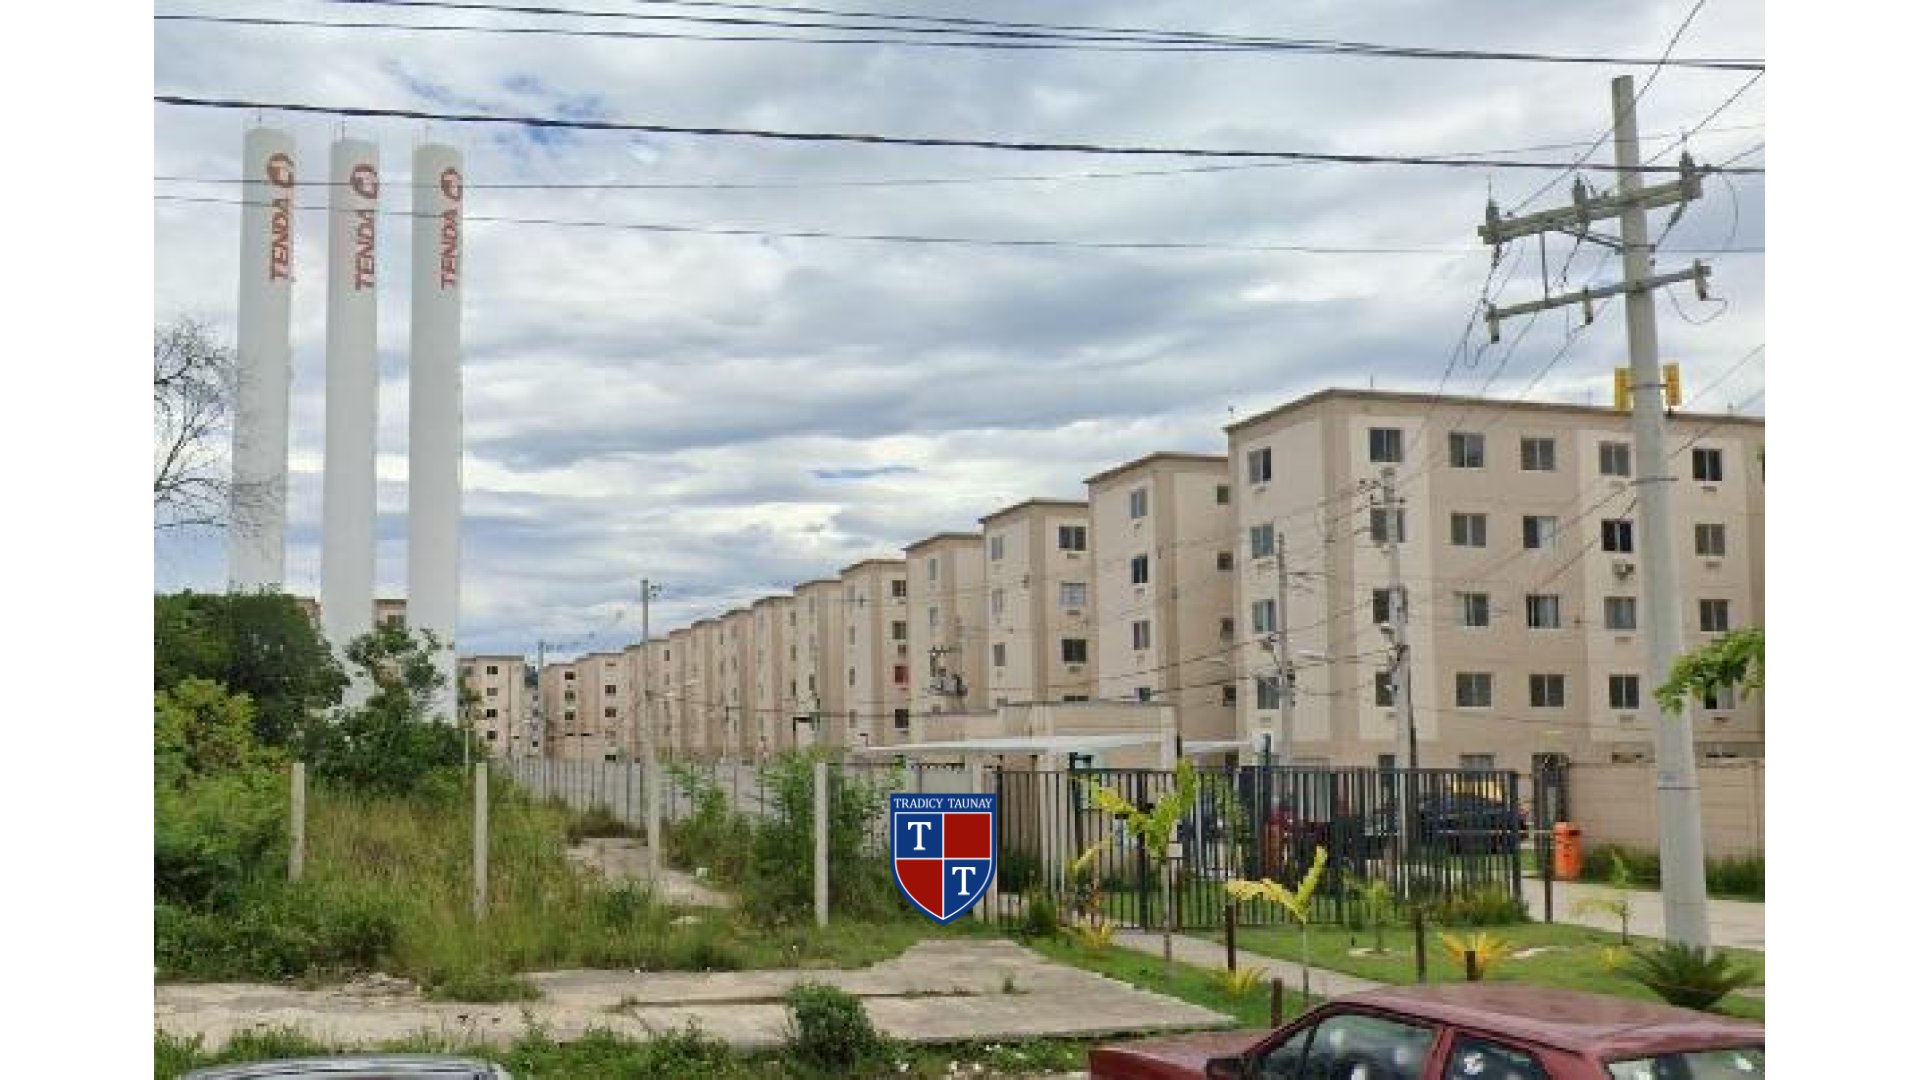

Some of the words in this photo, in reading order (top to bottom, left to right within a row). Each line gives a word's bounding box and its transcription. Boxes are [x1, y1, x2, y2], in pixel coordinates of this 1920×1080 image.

[270, 198, 289, 280] TENDA
[355, 208, 375, 290] TENDA
[441, 208, 458, 290] TENDA
